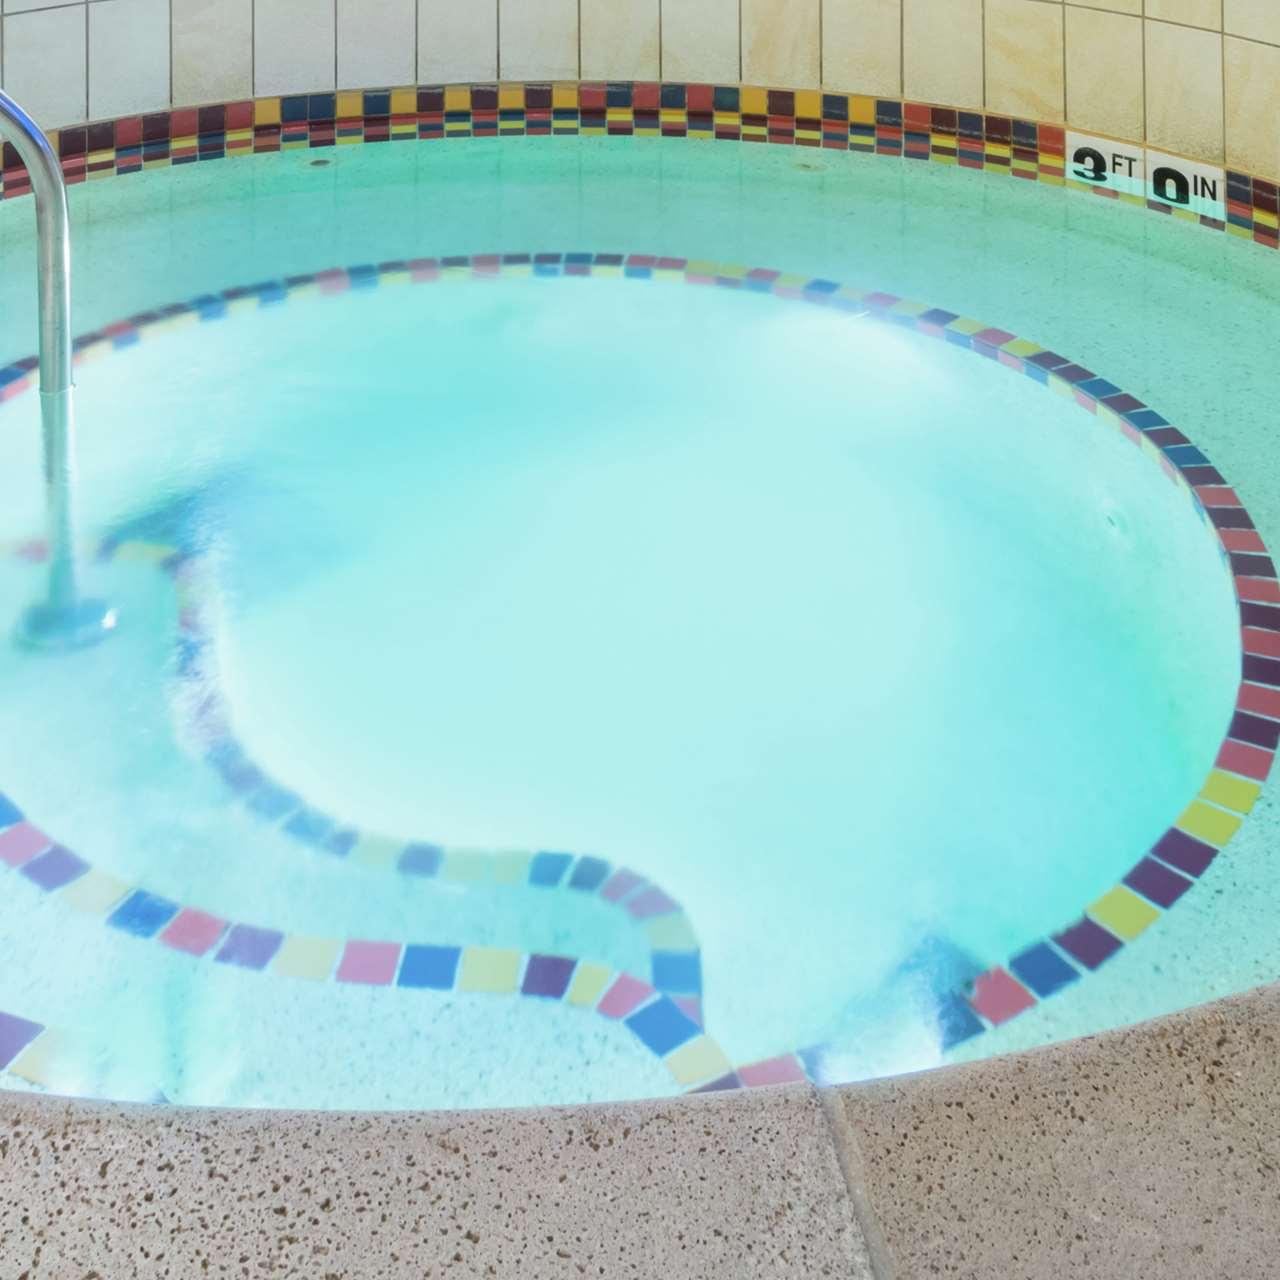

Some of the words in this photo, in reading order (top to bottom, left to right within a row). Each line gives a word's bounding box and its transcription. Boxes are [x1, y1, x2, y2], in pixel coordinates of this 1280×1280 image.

[1072, 146, 1108, 182] 3
[1111, 153, 1137, 178] FT
[1152, 166, 1190, 205] 0
[1193, 174, 1217, 201] IN
